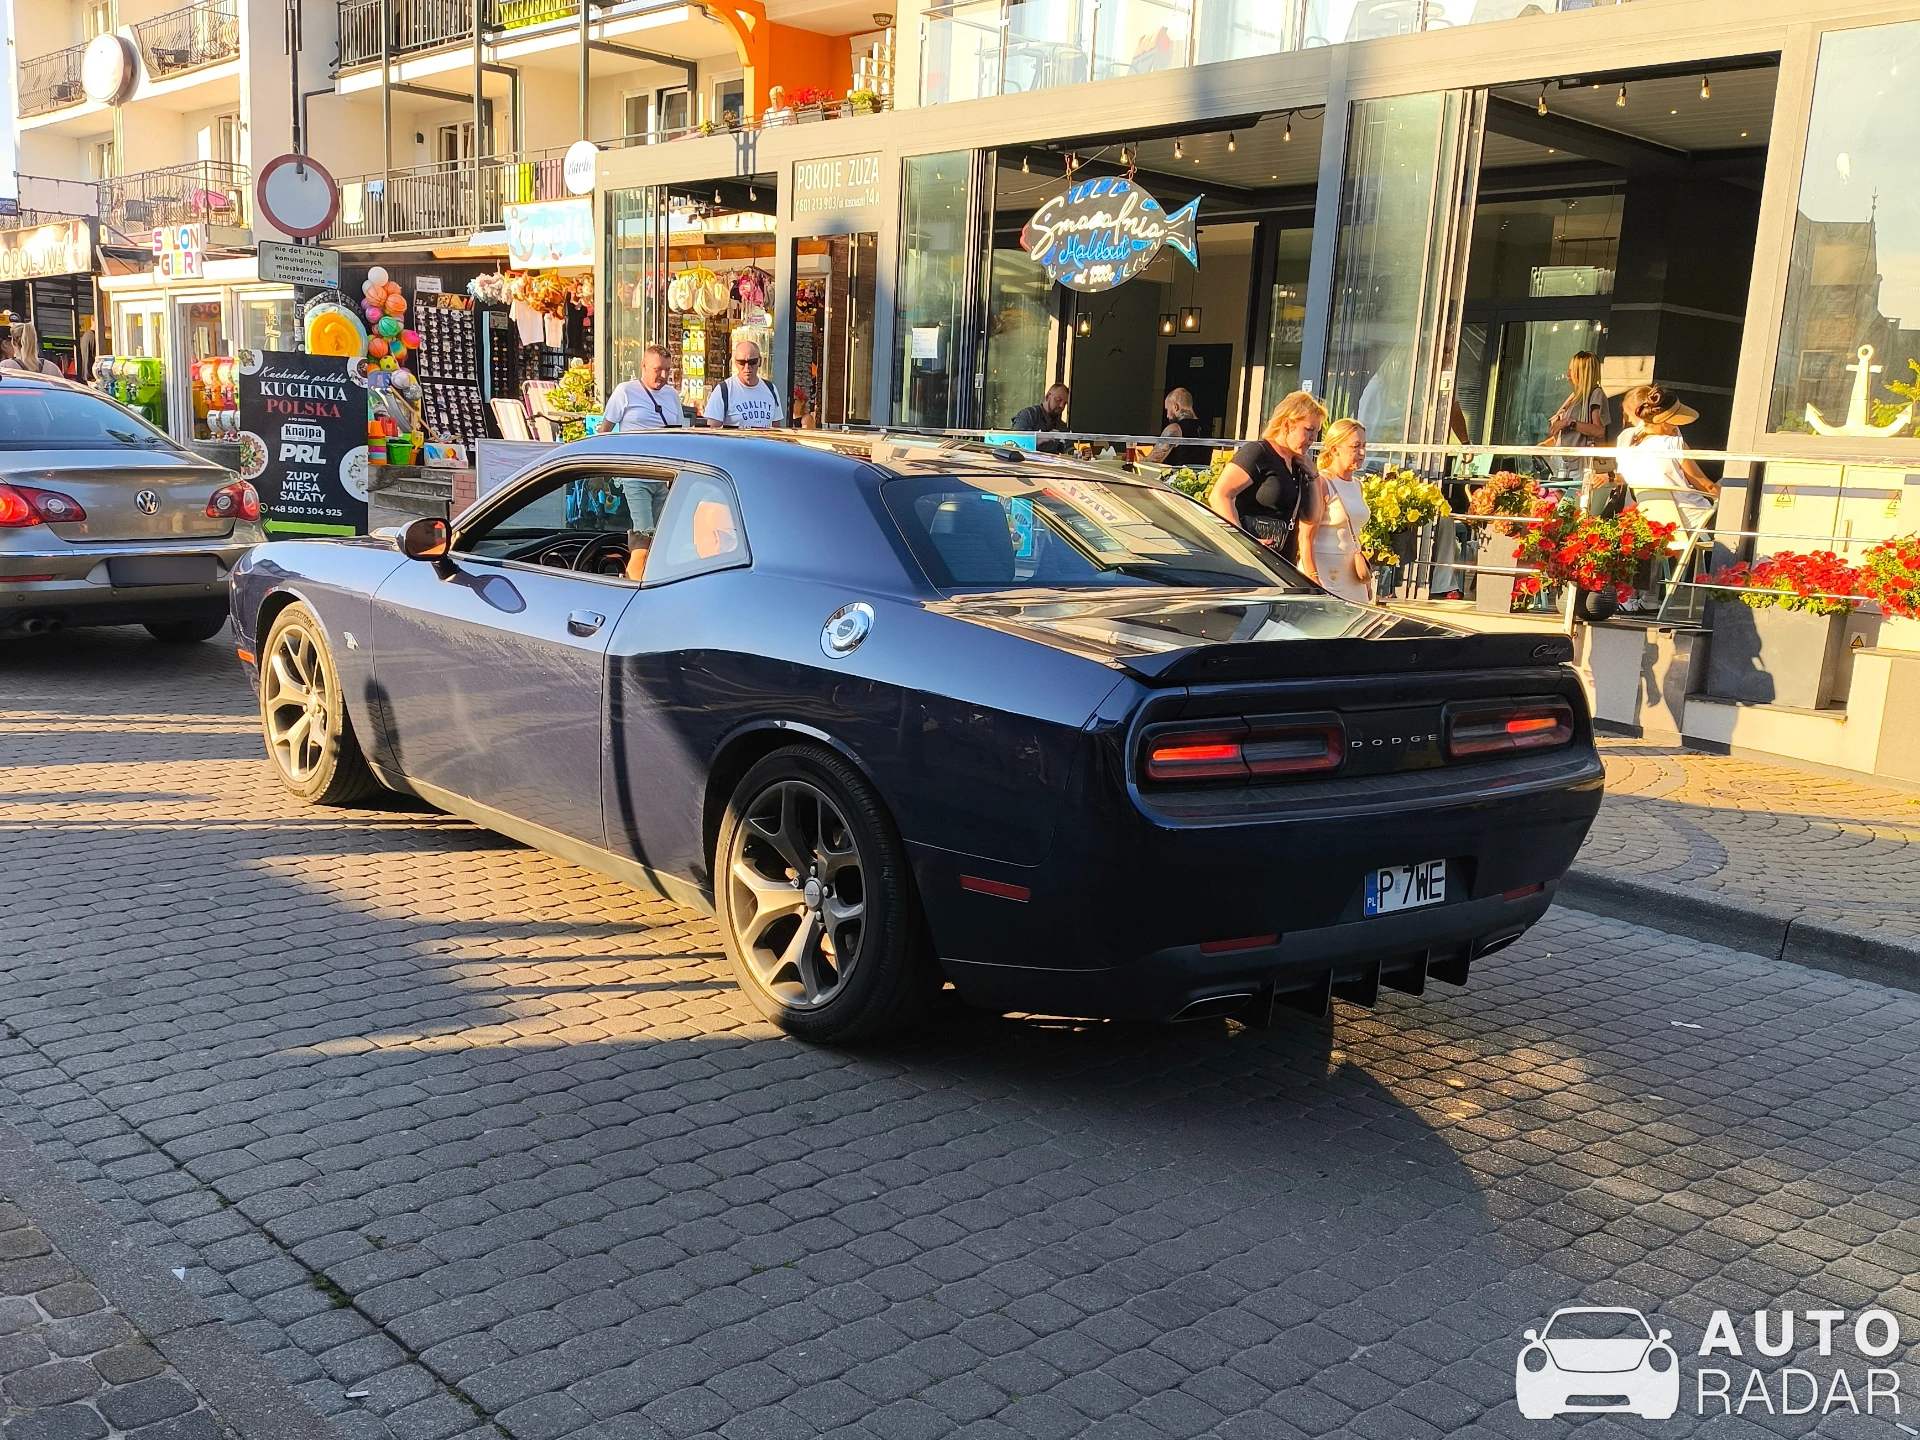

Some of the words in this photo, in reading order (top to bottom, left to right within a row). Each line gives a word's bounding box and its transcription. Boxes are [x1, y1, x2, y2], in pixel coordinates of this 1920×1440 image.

[797, 161, 842, 193] POKOJE
[848, 156, 879, 187] ZUZA
[799, 198, 811, 212] 601
[811, 197, 823, 211] 213
[153, 226, 200, 252] SALON
[1059, 230, 1131, 269] Halibut
[161, 251, 195, 276] GIER
[278, 273, 326, 284] zaopatrzenia
[259, 366, 310, 380] Kuchenka
[260, 381, 347, 401] KUCHNIA
[266, 398, 341, 418] POLSKA
[735, 400, 772, 413] QUALITY
[741, 410, 771, 421] GOODS
[285, 425, 322, 439] Knajpa
[279, 443, 327, 465] PRL
[286, 471, 319, 482] ZUPY
[282, 481, 321, 494] MIĘSA
[280, 491, 327, 502] SAŁATY
[269, 505, 286, 513] +48
[287, 506, 305, 514] 500
[306, 507, 324, 515] 304
[325, 508, 342, 517] 925
[1351, 733, 1438, 748] DODGE
[1366, 896, 1377, 908] PL
